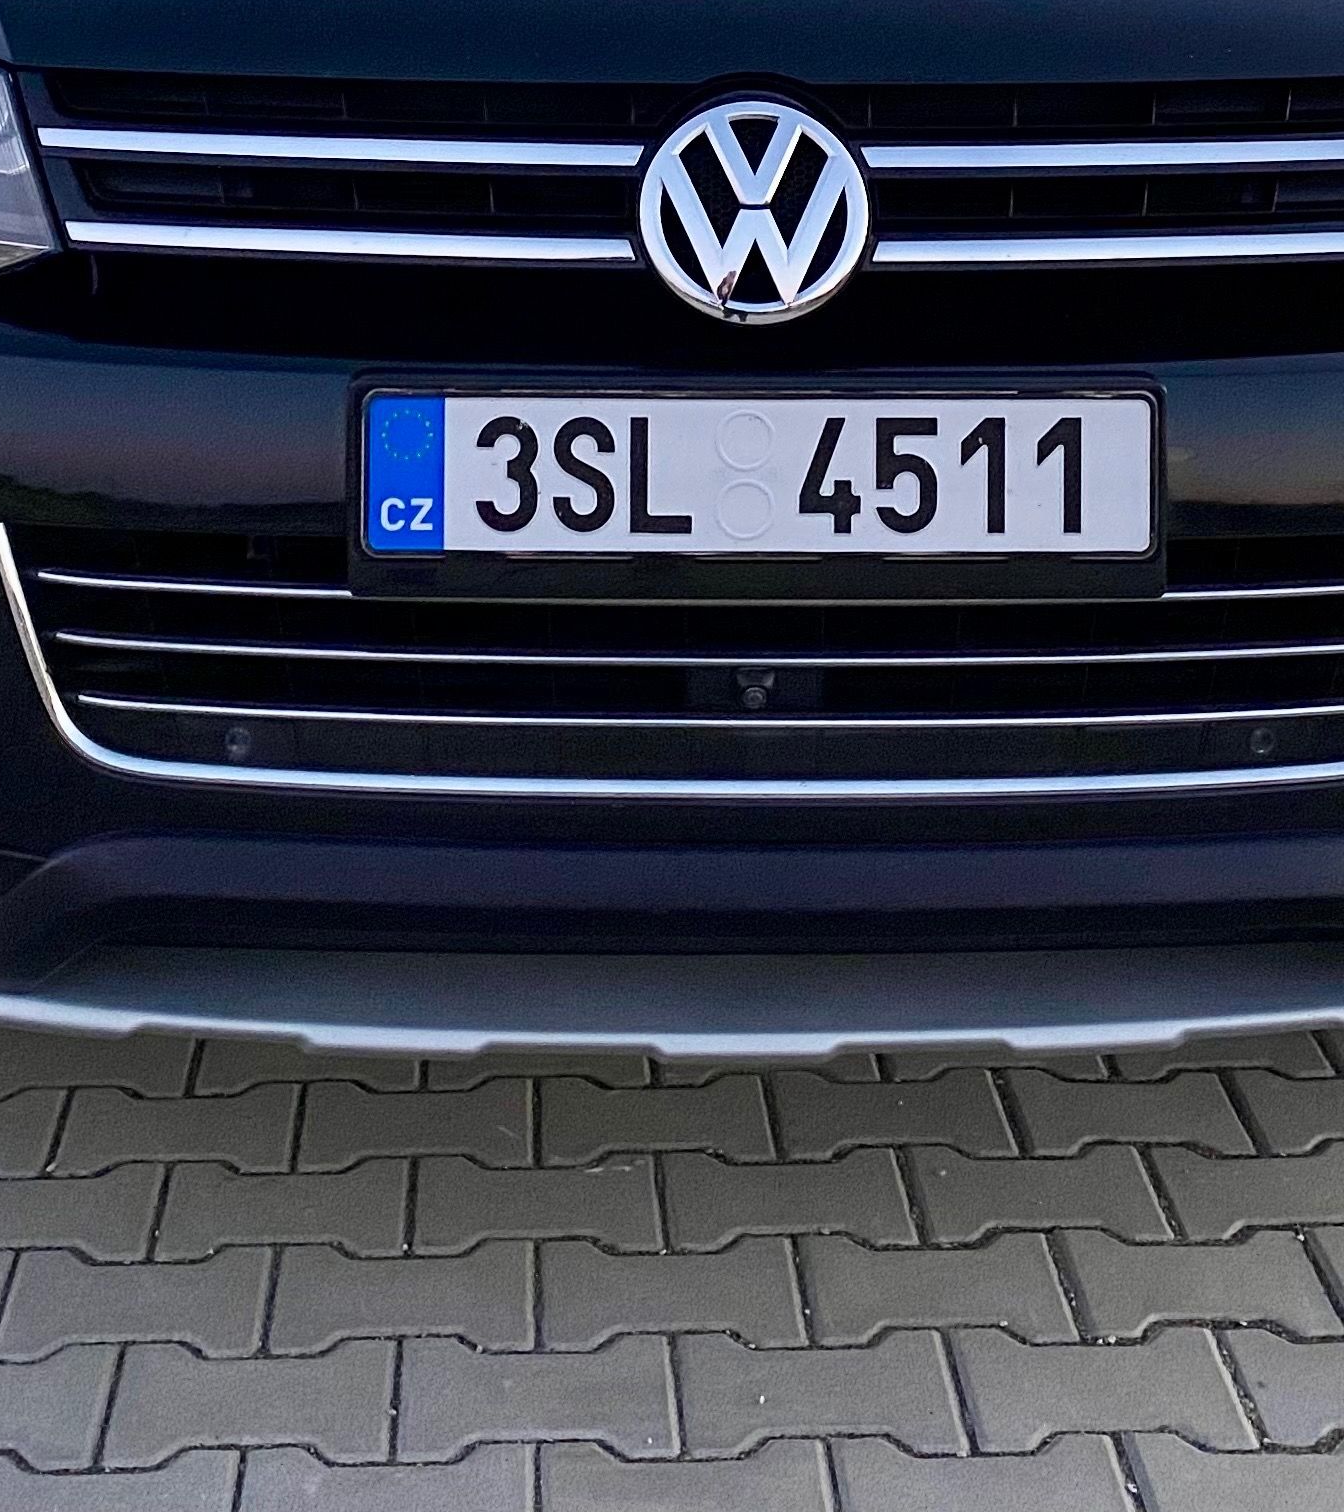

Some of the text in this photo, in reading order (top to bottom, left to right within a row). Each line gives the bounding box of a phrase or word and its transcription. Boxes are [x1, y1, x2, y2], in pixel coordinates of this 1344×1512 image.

[648, 101, 860, 314] VW
[380, 497, 434, 532] CZ
[475, 416, 1083, 534] 3SL 4511
